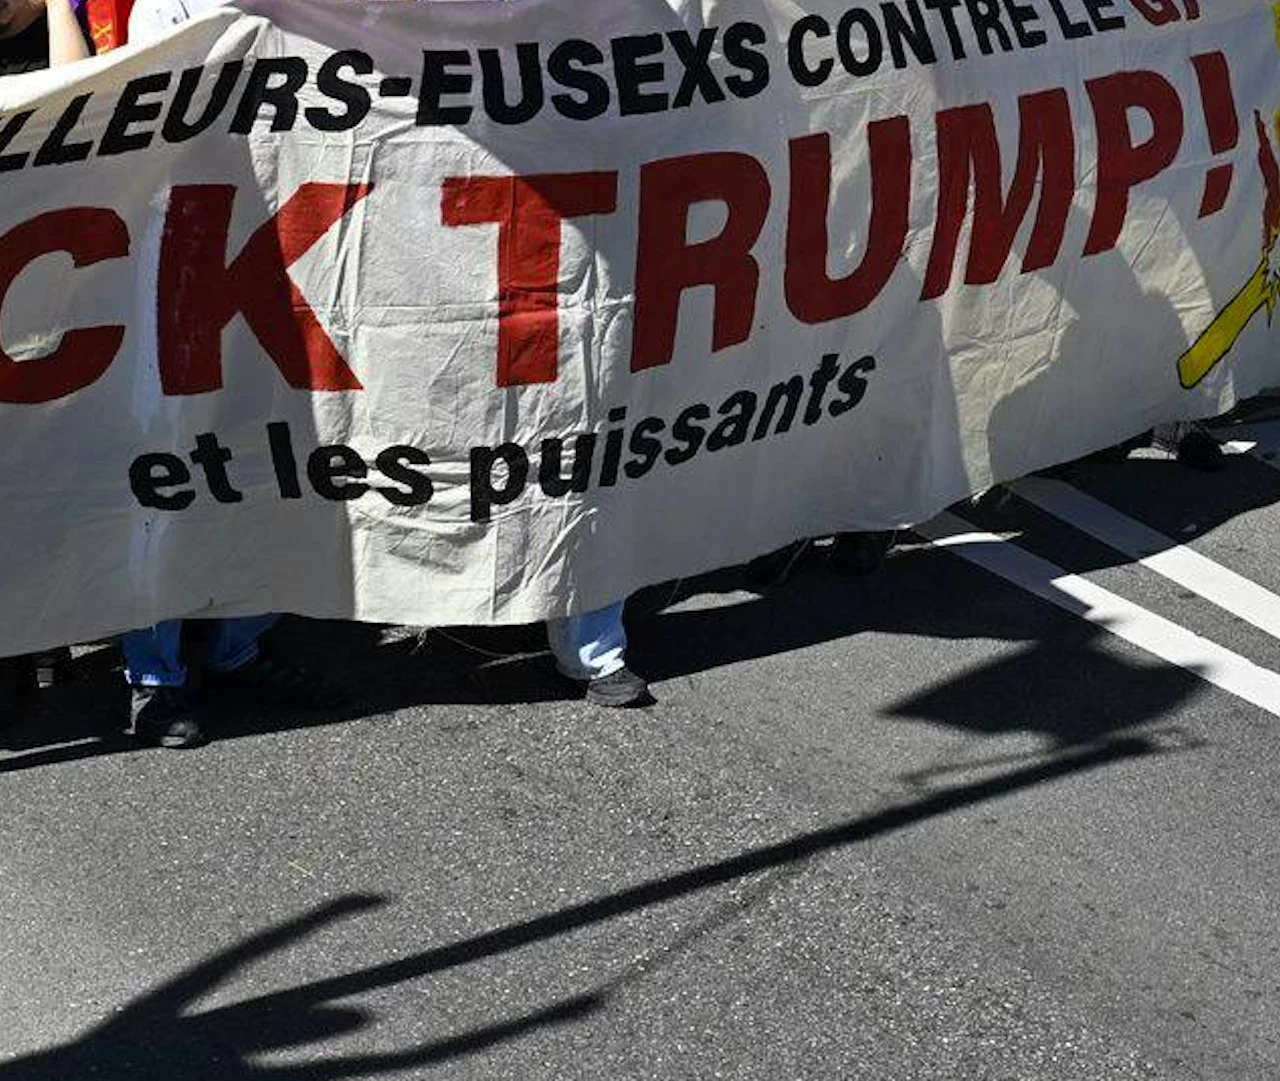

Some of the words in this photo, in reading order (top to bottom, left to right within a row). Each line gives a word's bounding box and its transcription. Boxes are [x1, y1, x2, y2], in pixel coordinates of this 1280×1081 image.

[441, 50, 1240, 388] TRUMP!
[129, 433, 244, 512] et
[269, 420, 433, 508] les
[470, 352, 877, 522] puissants
